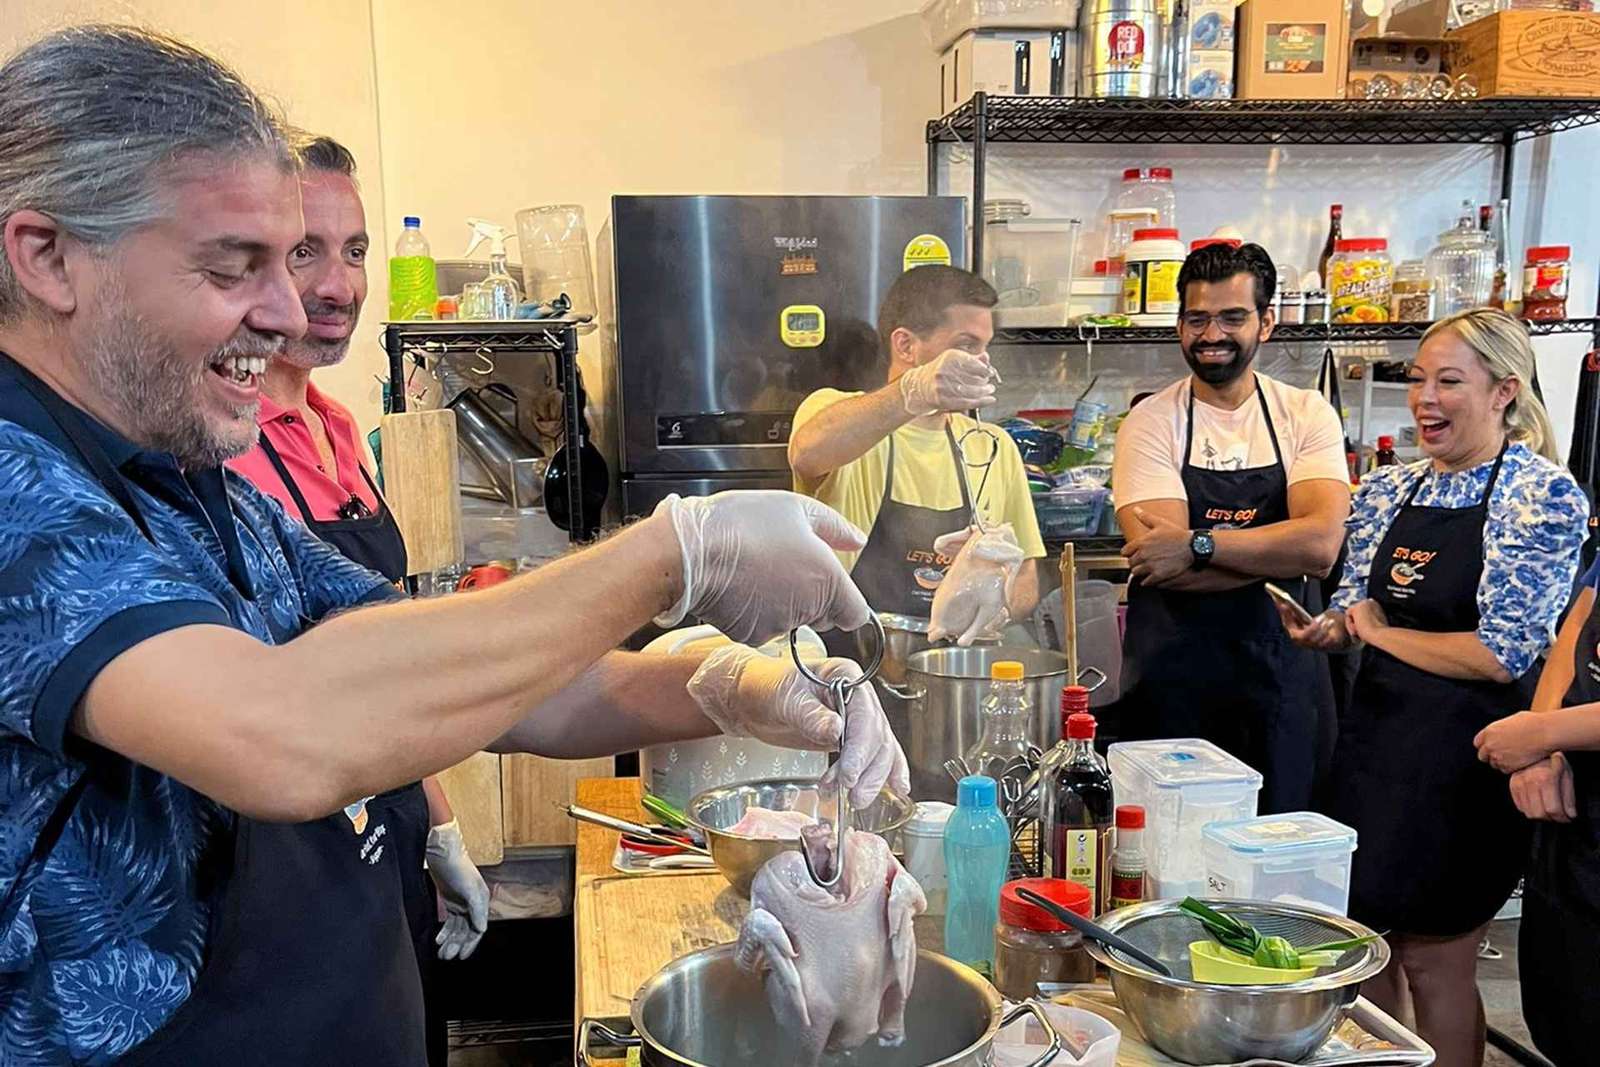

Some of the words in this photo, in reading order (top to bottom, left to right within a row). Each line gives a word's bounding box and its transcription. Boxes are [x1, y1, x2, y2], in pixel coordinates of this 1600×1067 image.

[1117, 25, 1138, 40] RED
[1117, 40, 1137, 54] DOT
[1234, 508, 1257, 521] GO!
[1410, 550, 1437, 563] GO!
[1208, 876, 1227, 892] SALT
